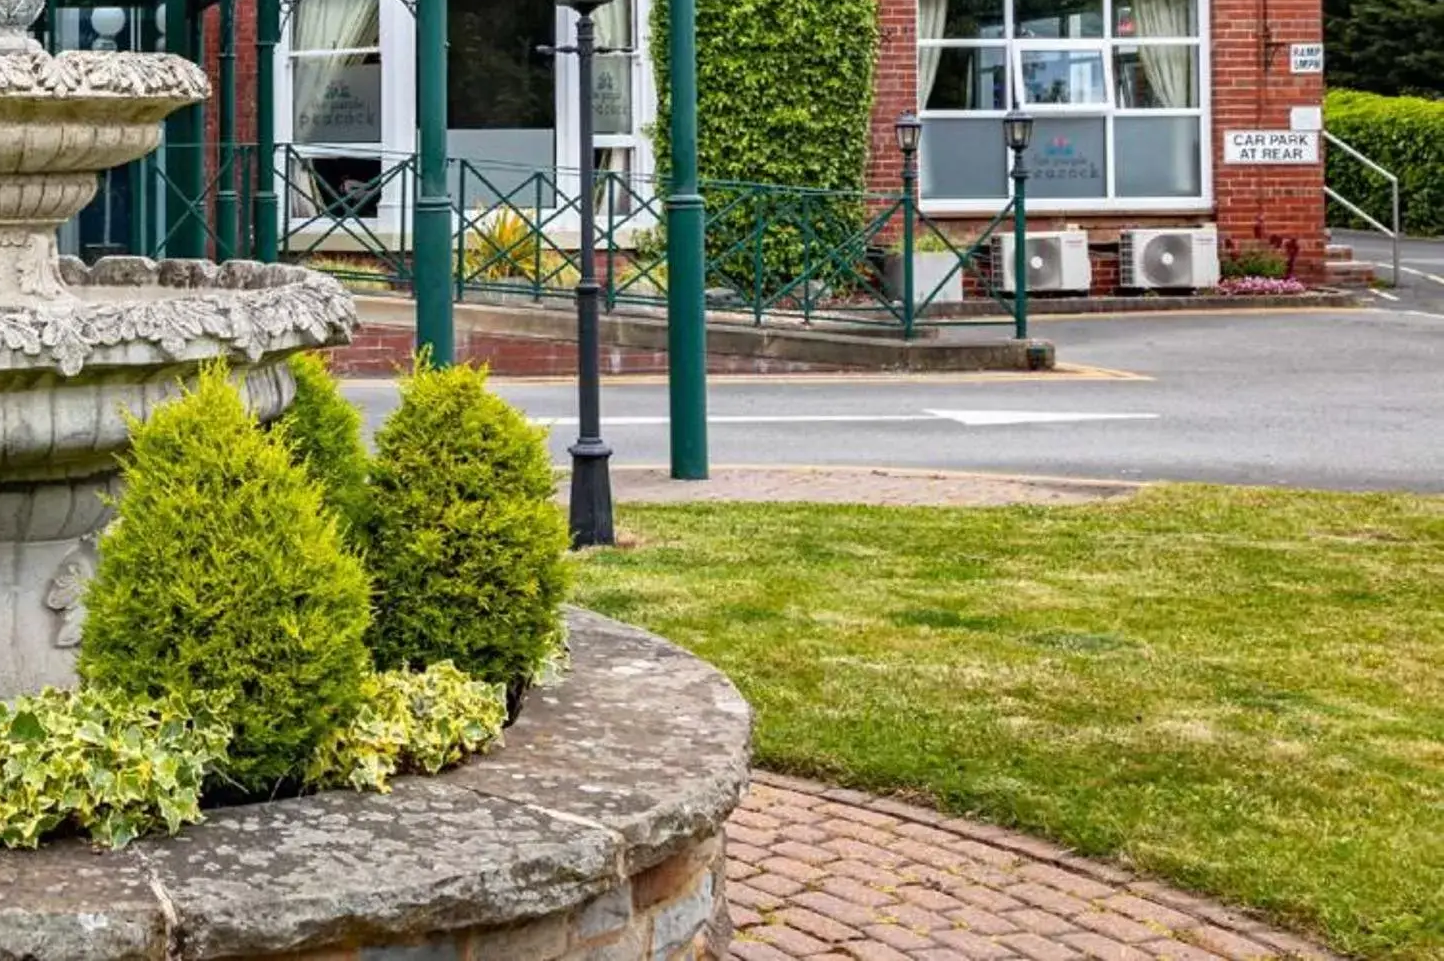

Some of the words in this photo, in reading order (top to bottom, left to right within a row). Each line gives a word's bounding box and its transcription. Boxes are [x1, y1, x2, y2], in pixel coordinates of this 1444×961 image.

[1233, 134, 1266, 146] CAR
[1269, 134, 1308, 146] PARK
[1239, 148, 1256, 159] AT
[1262, 148, 1303, 159] REAR
[1032, 161, 1101, 179] eacock
